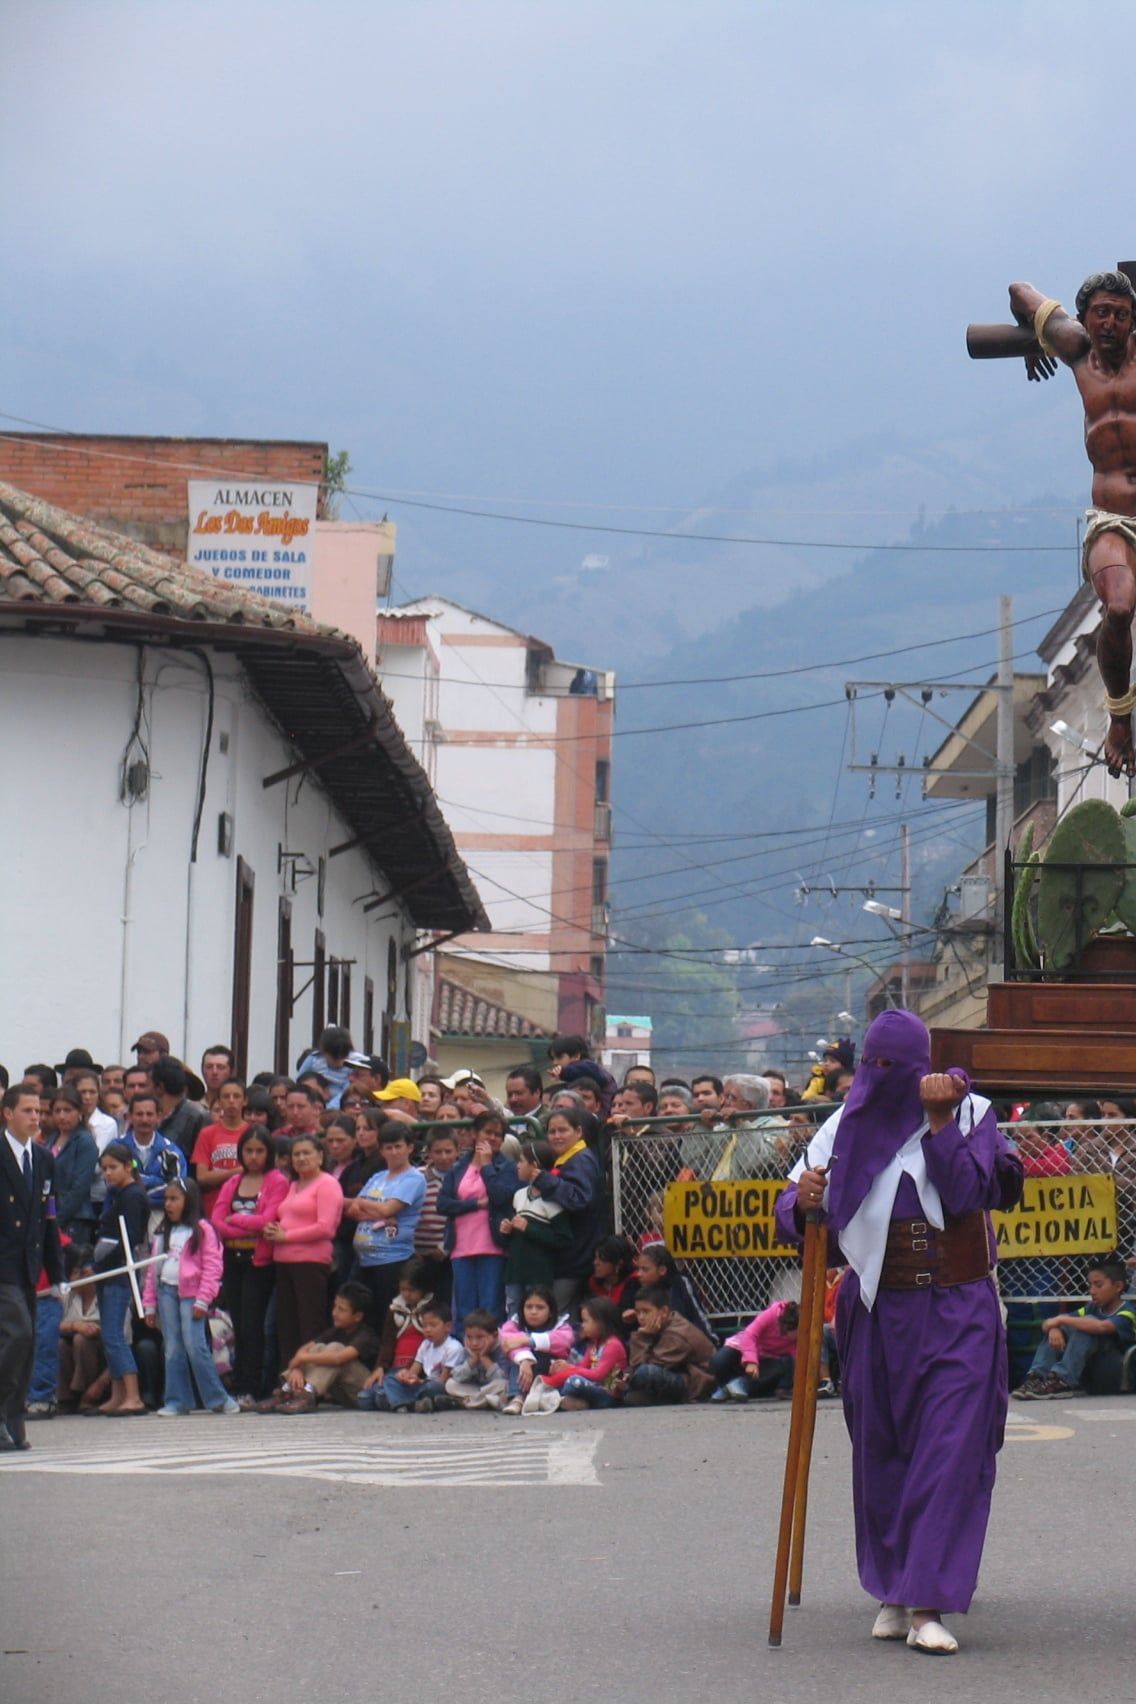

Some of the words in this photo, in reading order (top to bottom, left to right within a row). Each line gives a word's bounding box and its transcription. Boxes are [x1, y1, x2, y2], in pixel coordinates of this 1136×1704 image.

[213, 489, 293, 506] ALMACEN
[194, 550, 246, 561] JUEGOS
[251, 551, 268, 562] DE
[273, 552, 306, 563] SALA
[212, 568, 220, 577] Y
[224, 568, 291, 580] COMEDOR
[1004, 1186, 1095, 1214] LICIA
[673, 1223, 799, 1252] NACION
[996, 1217, 1113, 1246] ACIONAL
